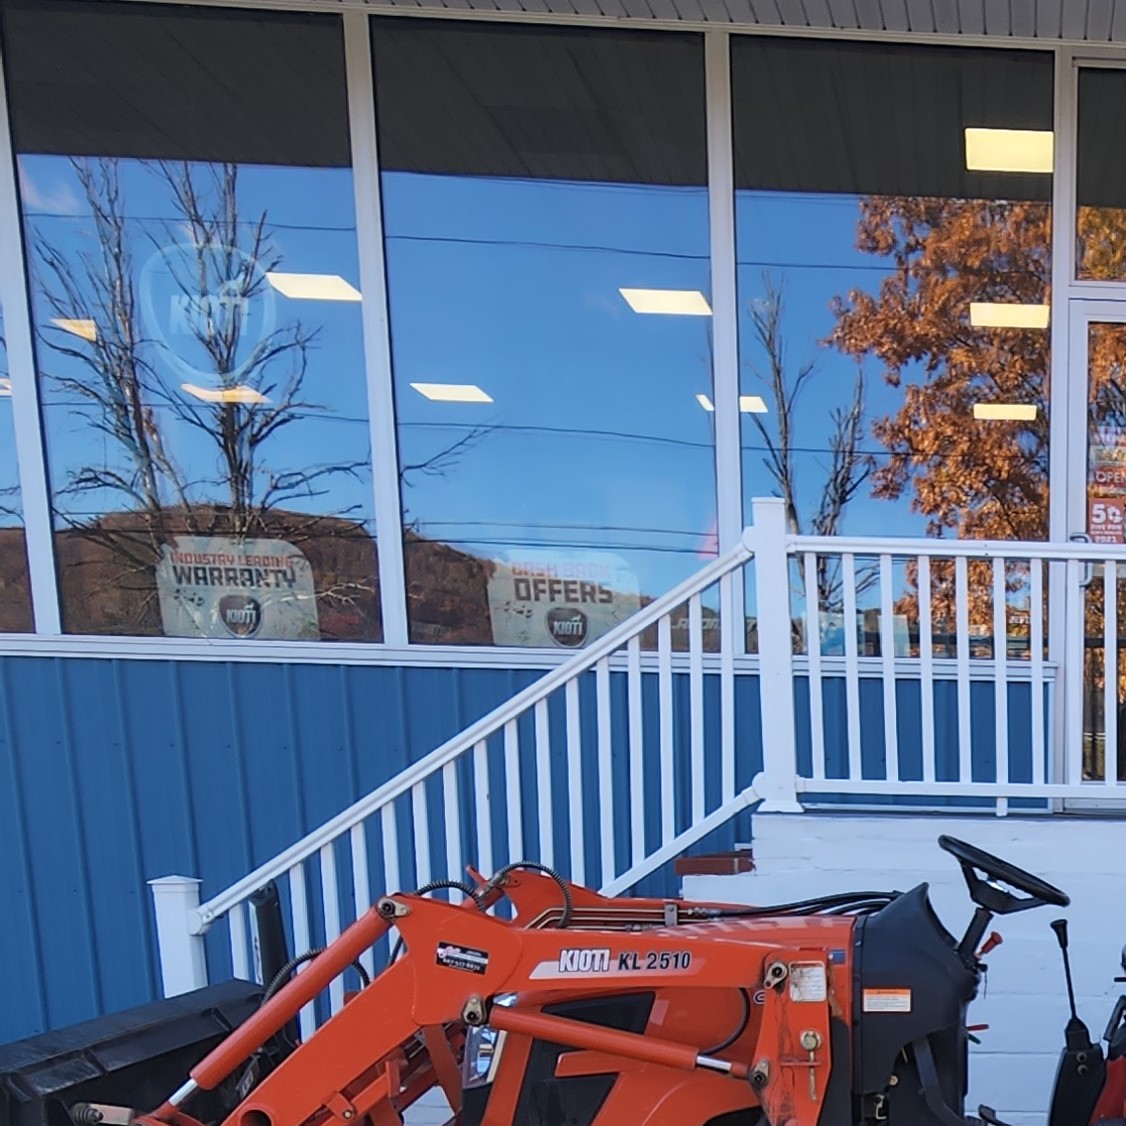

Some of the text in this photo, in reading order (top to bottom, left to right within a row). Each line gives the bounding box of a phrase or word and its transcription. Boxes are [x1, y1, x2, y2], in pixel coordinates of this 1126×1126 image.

[171, 552, 295, 568] INDUSTRY LEADING
[173, 565, 297, 588] WARRANTY
[513, 577, 614, 604] OFFERS
[226, 606, 256, 625] KIOTI
[553, 617, 583, 636] KIOTI
[558, 948, 691, 972] KIOTI KL 2510
